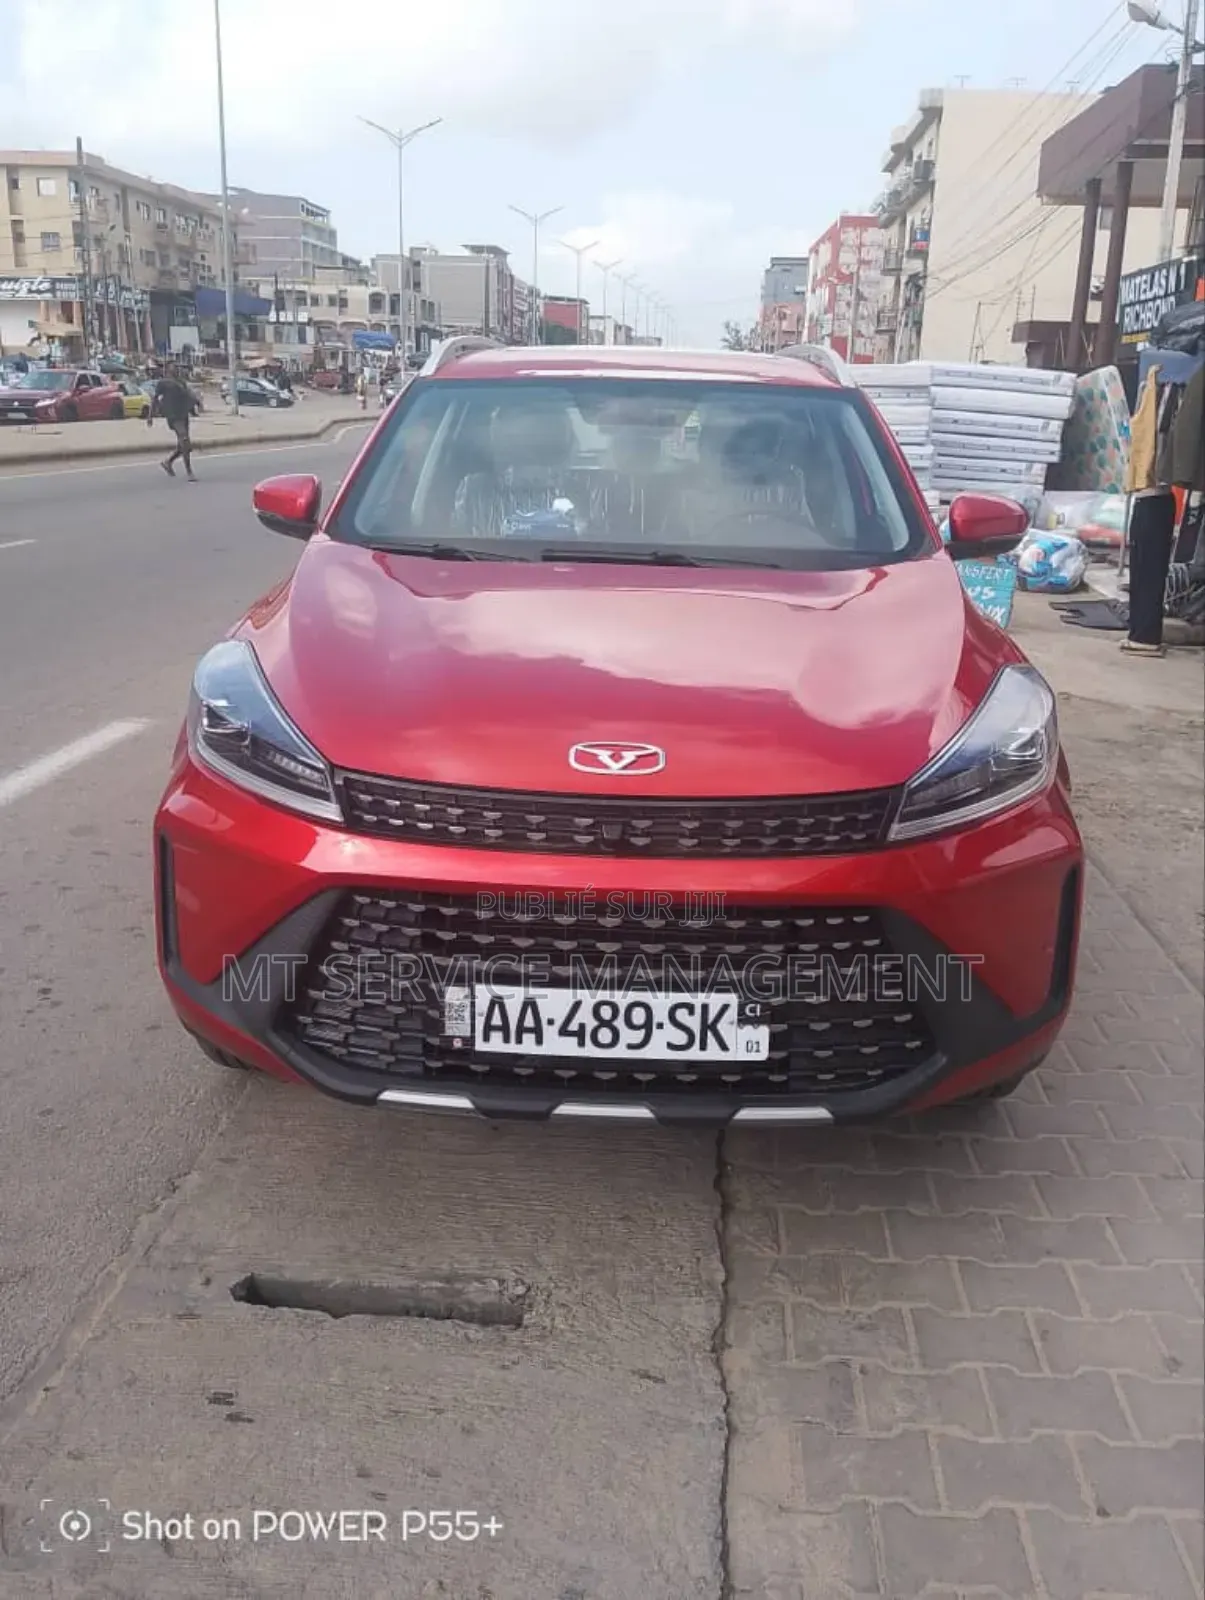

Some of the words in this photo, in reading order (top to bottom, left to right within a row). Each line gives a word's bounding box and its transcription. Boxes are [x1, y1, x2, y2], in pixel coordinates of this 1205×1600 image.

[1120, 268, 1168, 305] MATELAS
[745, 1003, 761, 1017] CI
[746, 1040, 761, 1053] 01
